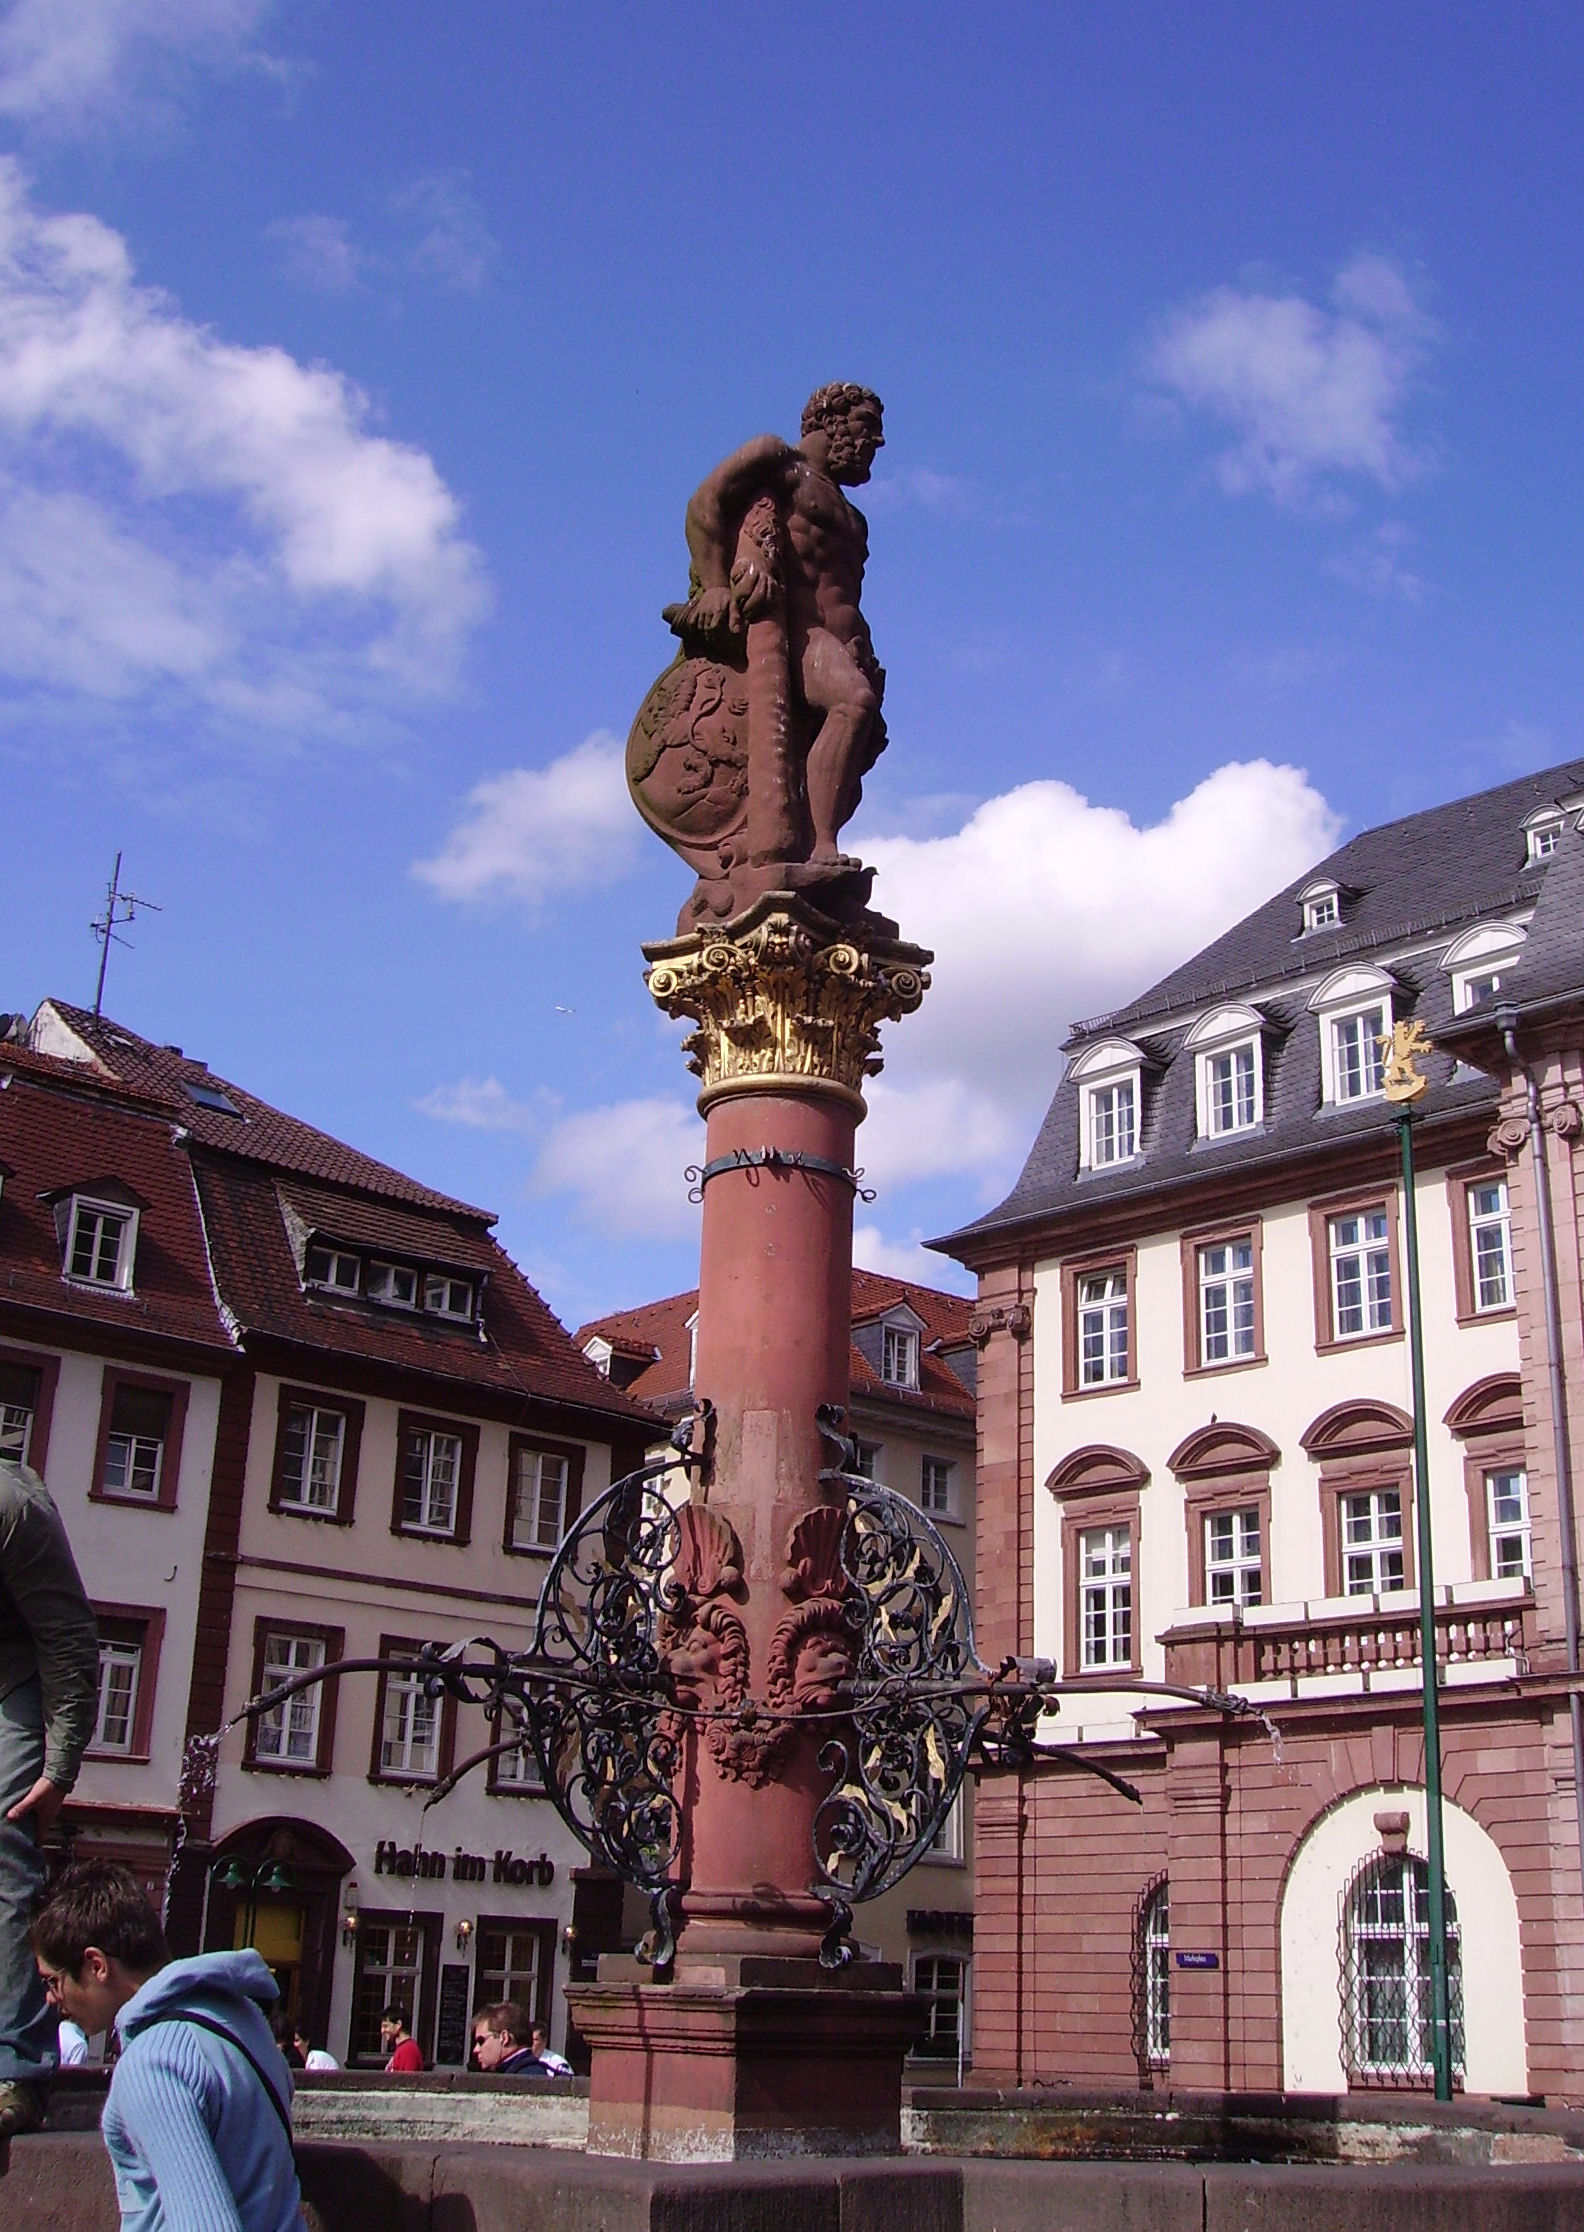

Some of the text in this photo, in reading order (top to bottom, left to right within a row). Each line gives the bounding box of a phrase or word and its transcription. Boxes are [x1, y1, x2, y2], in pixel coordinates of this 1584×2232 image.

[374, 1840, 555, 1886] Hahn im Korb
